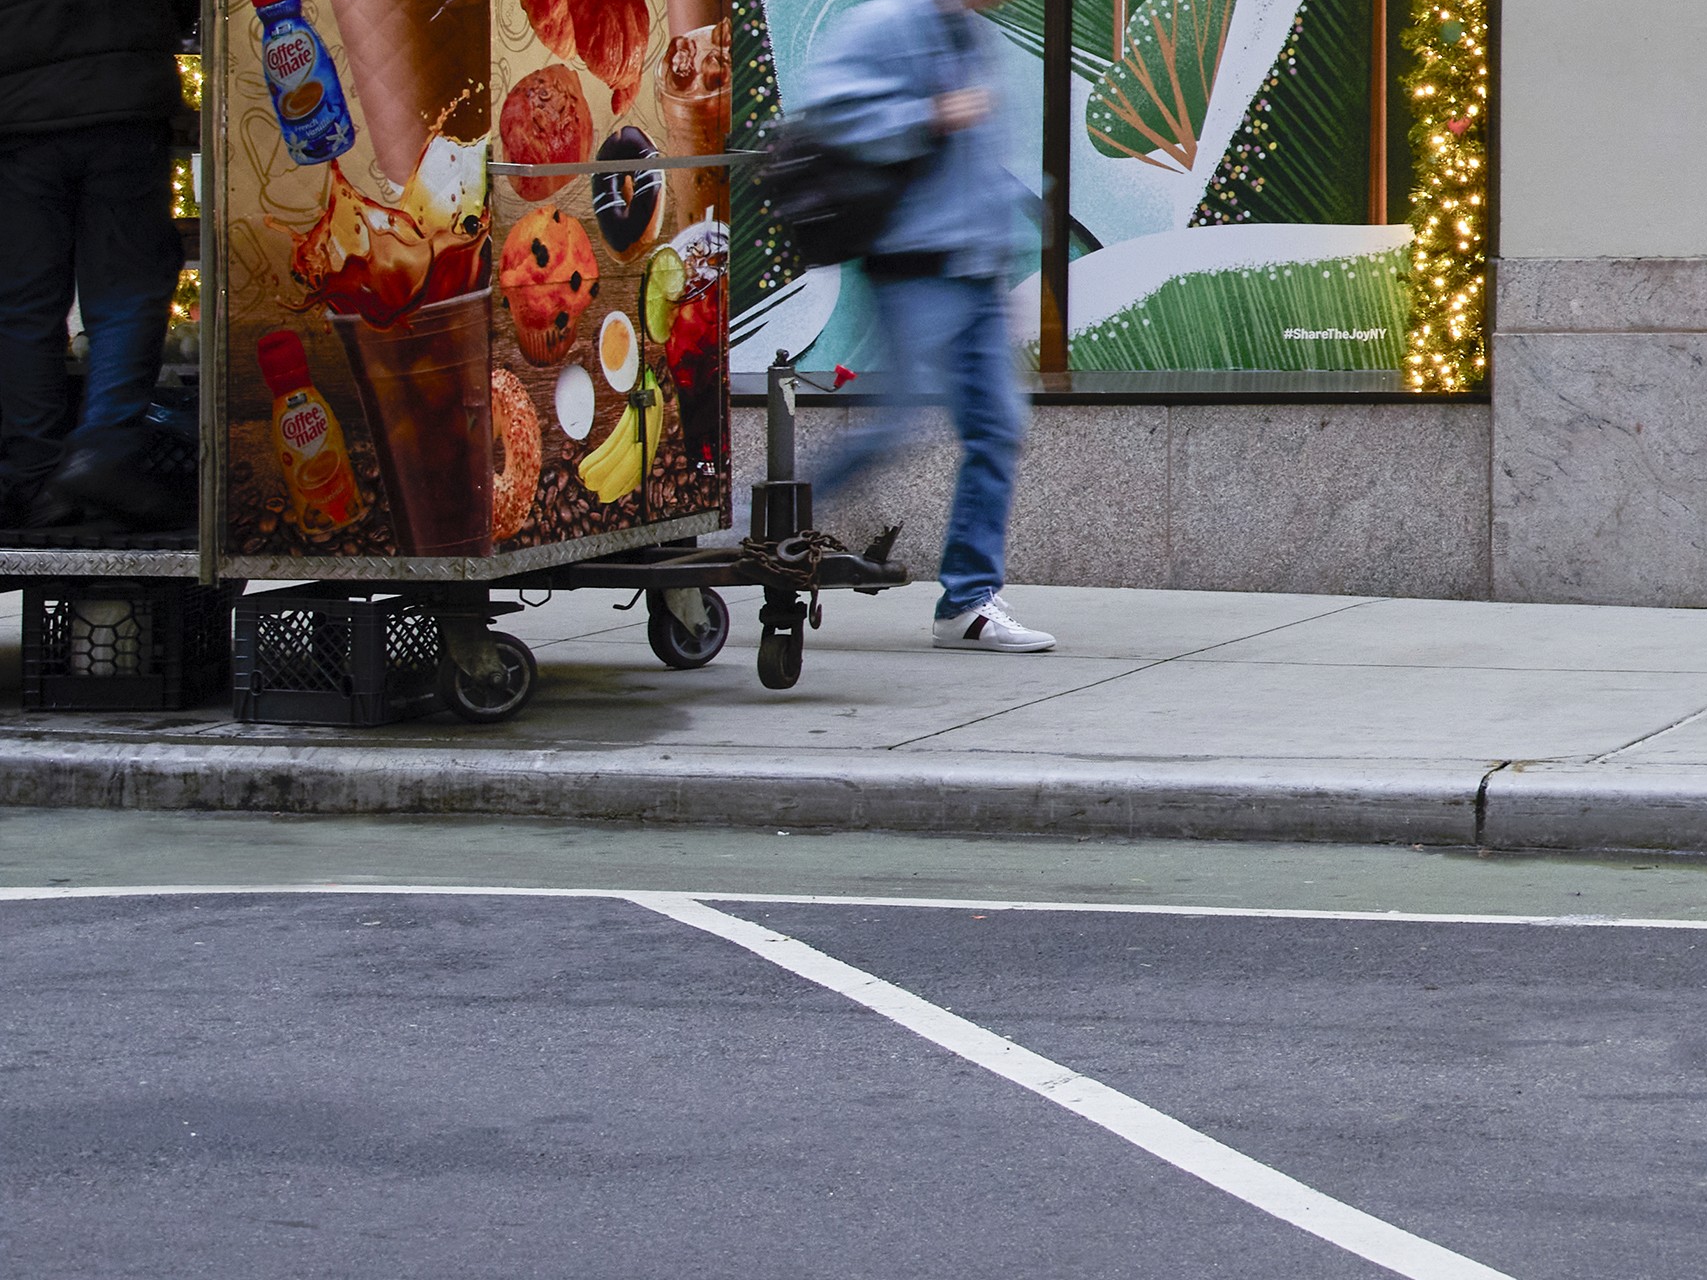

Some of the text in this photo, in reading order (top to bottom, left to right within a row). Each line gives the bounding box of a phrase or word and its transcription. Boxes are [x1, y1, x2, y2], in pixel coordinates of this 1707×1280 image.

[278, 49, 313, 79] mate
[1283, 328, 1387, 342] #ShareTheJoyNY
[296, 418, 329, 448] mate
